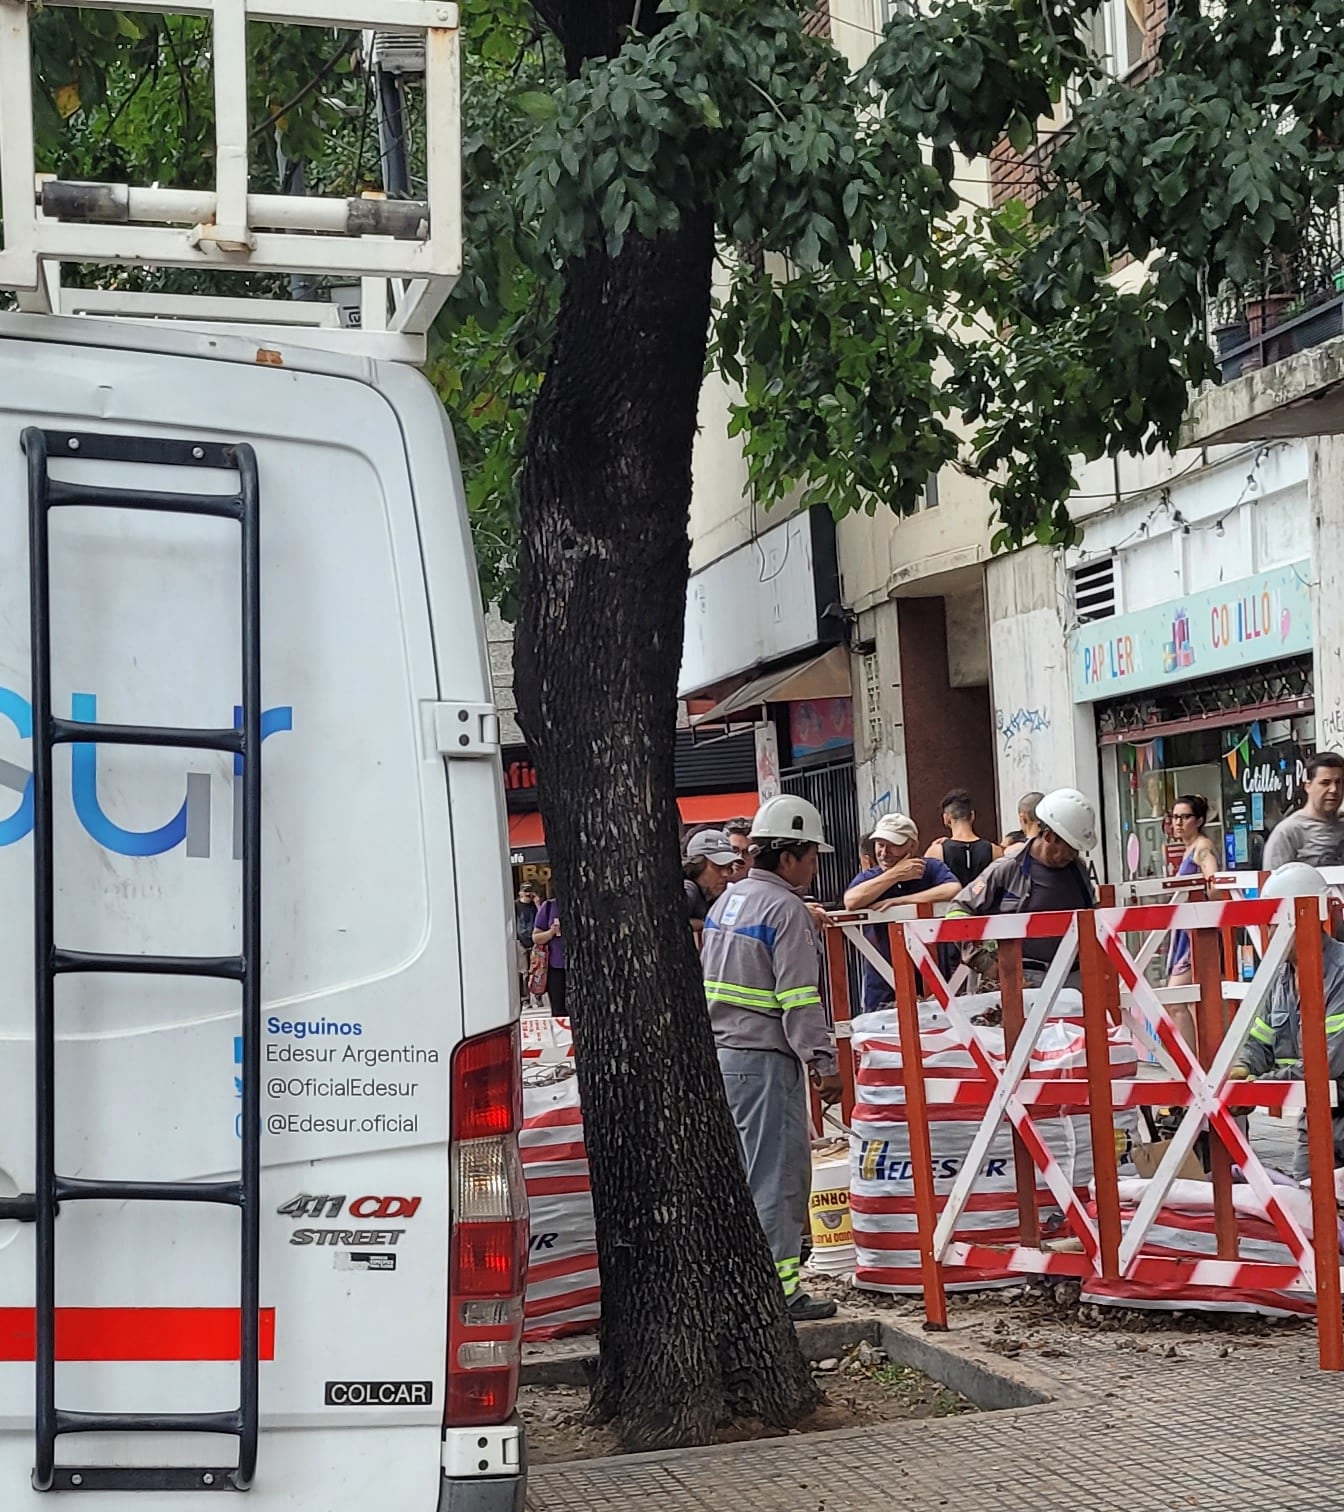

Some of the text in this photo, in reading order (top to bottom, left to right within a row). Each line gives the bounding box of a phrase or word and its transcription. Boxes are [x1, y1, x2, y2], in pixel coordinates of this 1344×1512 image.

[1243, 764, 1282, 793] Cotillón
[1286, 774, 1293, 800] y
[267, 1017, 362, 1039] Seguinos
[266, 1044, 439, 1066] Edesur Argentina
[267, 1078, 418, 1098] @OficialEdesur
[267, 1114, 418, 1134] @Edesur.oficial
[888, 1158, 1007, 1181] EDSR
[277, 1193, 422, 1218] 411 CDI
[289, 1229, 405, 1245] STREET
[330, 1383, 426, 1403] COLCAR
